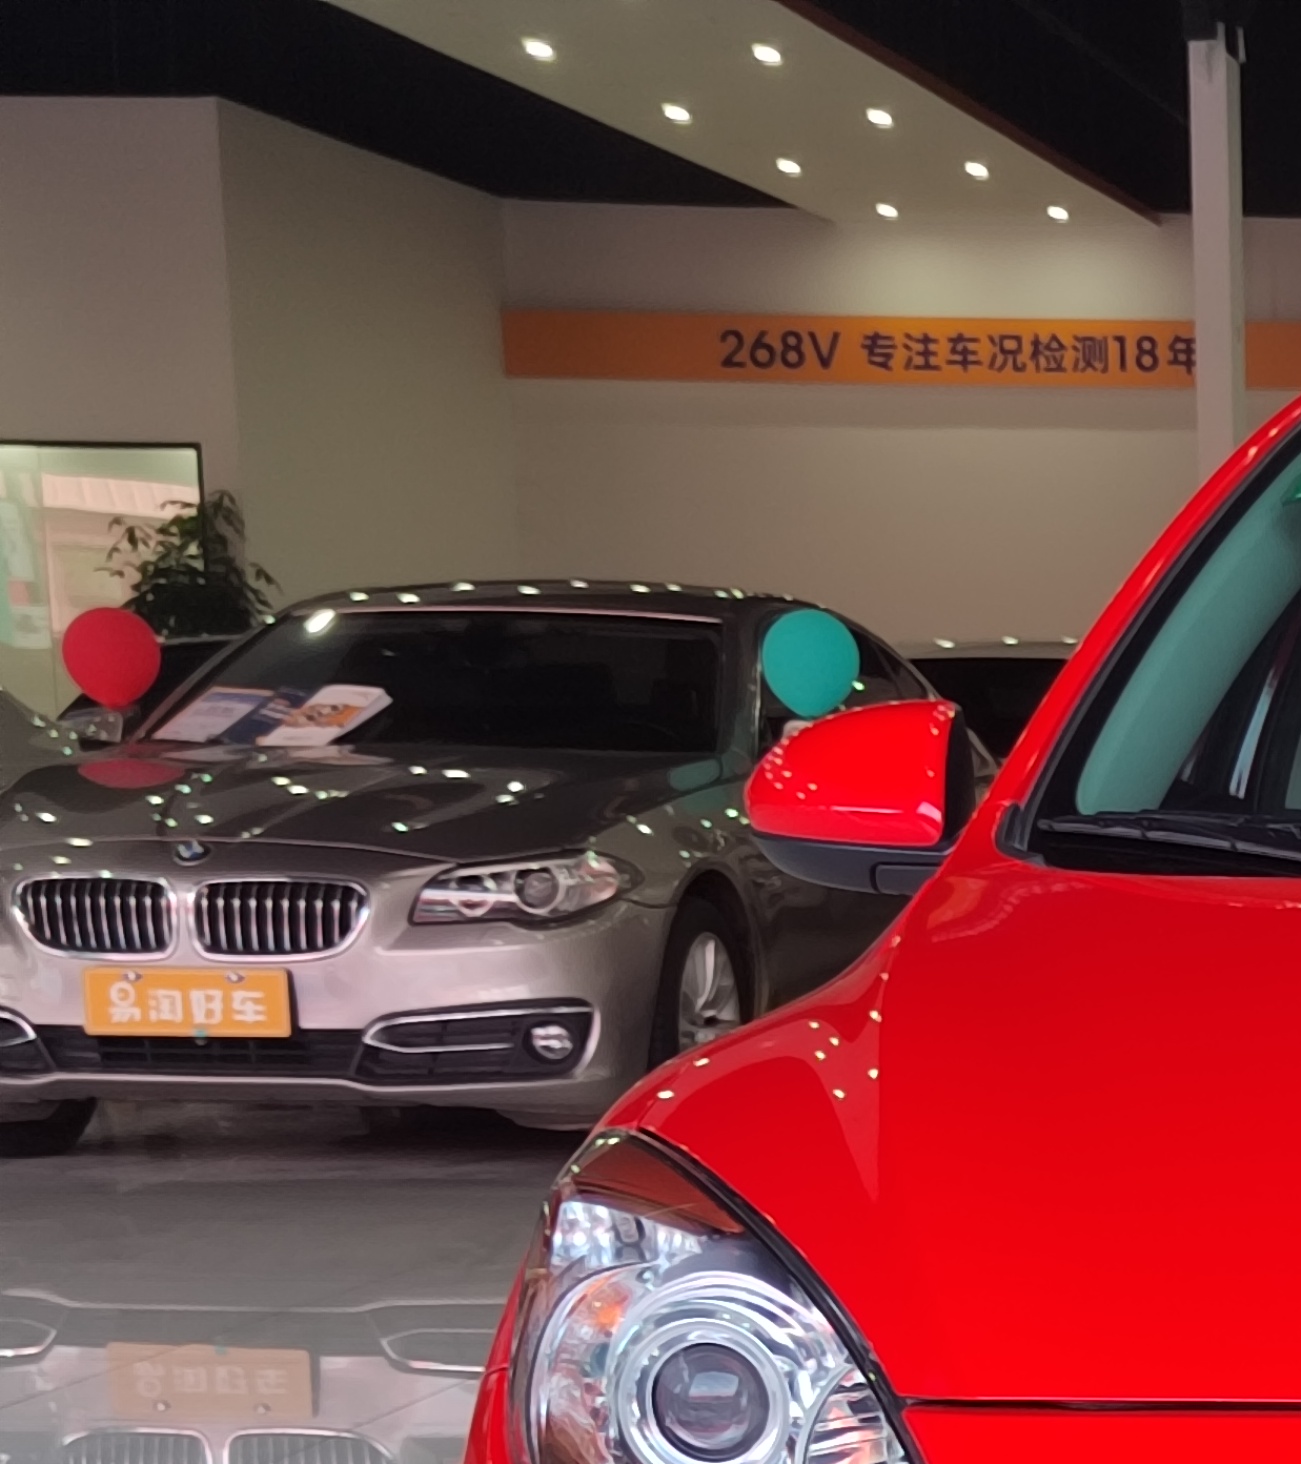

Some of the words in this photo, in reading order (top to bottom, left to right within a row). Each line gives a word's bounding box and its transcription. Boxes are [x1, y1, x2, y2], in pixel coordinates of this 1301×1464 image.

[719, 329, 841, 370] 268V
[862, 331, 1196, 375] 专注车况检测18年
[108, 981, 267, 1024] 易淘好车
